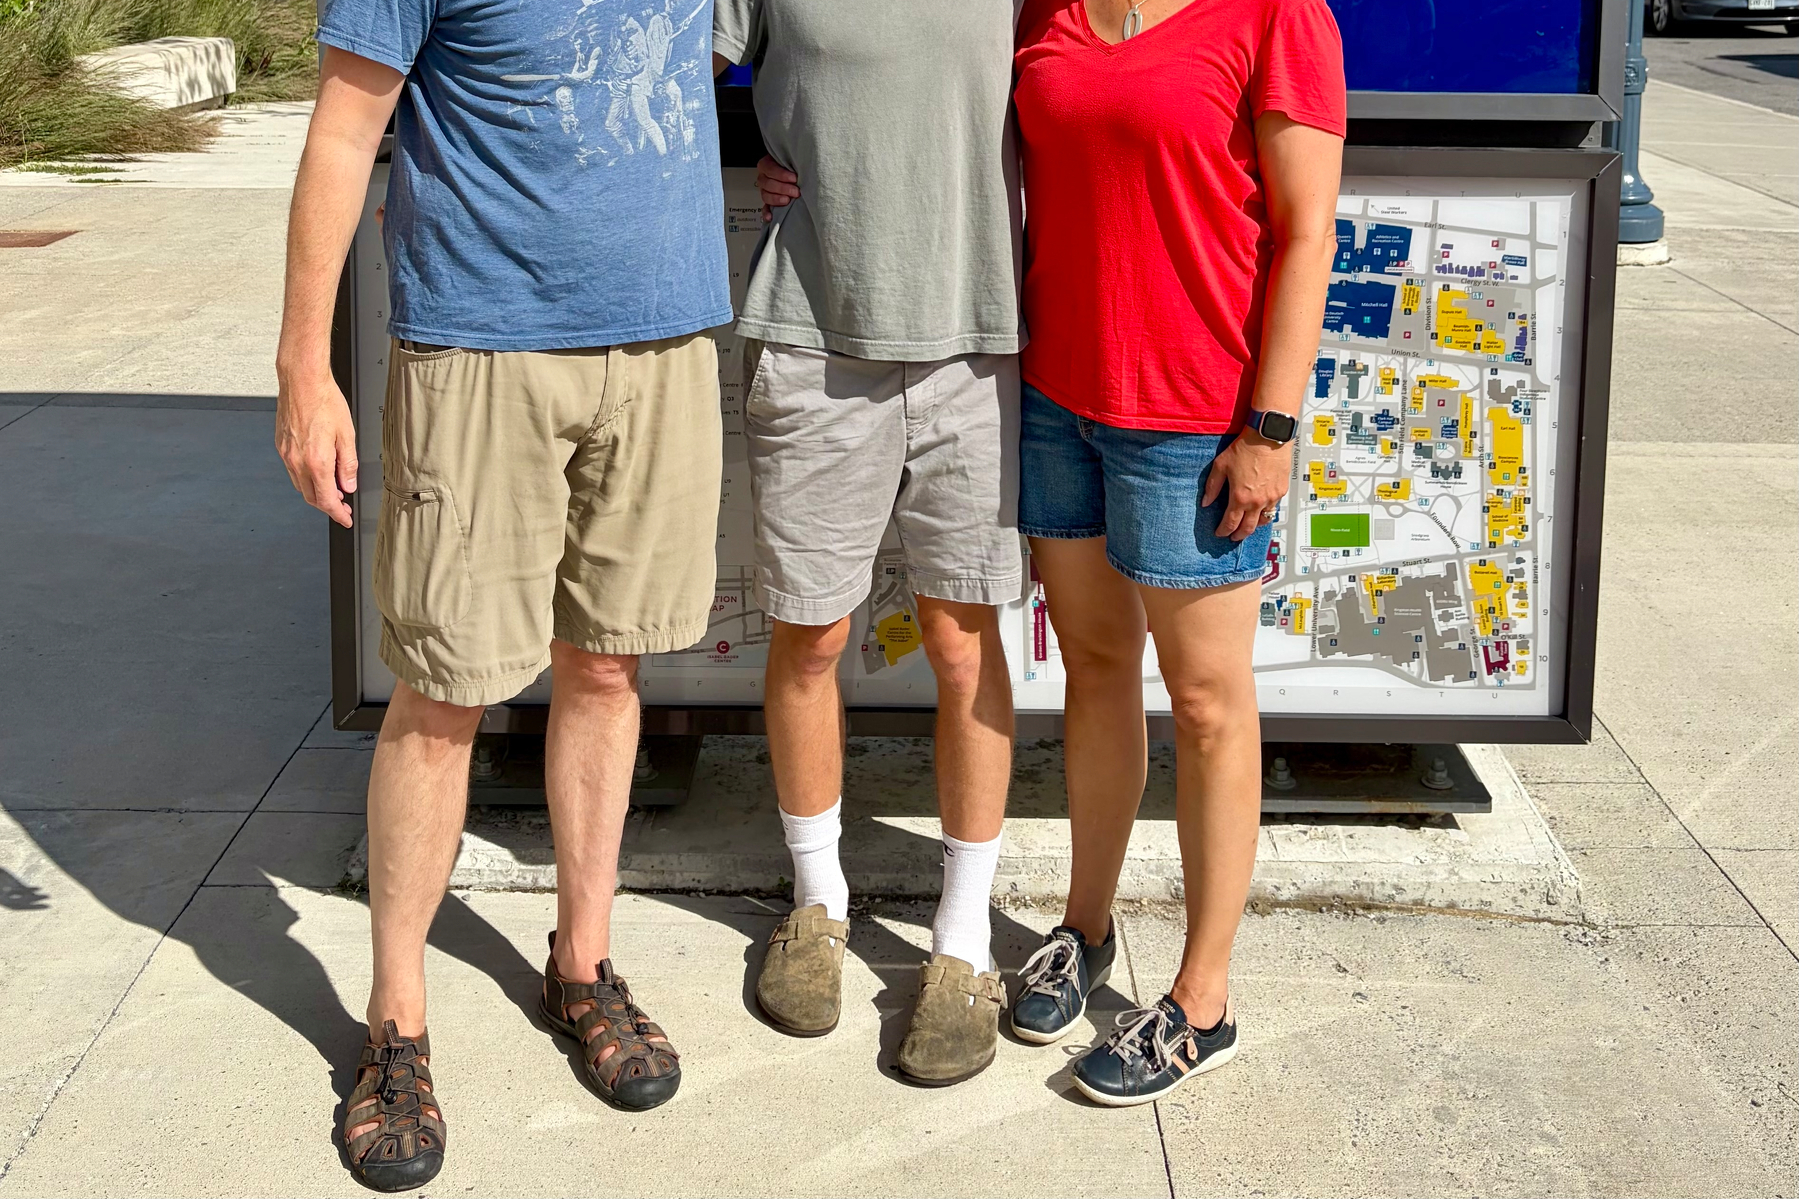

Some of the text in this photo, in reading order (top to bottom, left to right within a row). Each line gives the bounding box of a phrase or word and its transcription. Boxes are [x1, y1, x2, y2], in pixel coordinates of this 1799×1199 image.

[1461, 277, 1482, 287] Clergy
[1291, 449, 1301, 480] University
[1430, 512, 1461, 549] Founders Row
